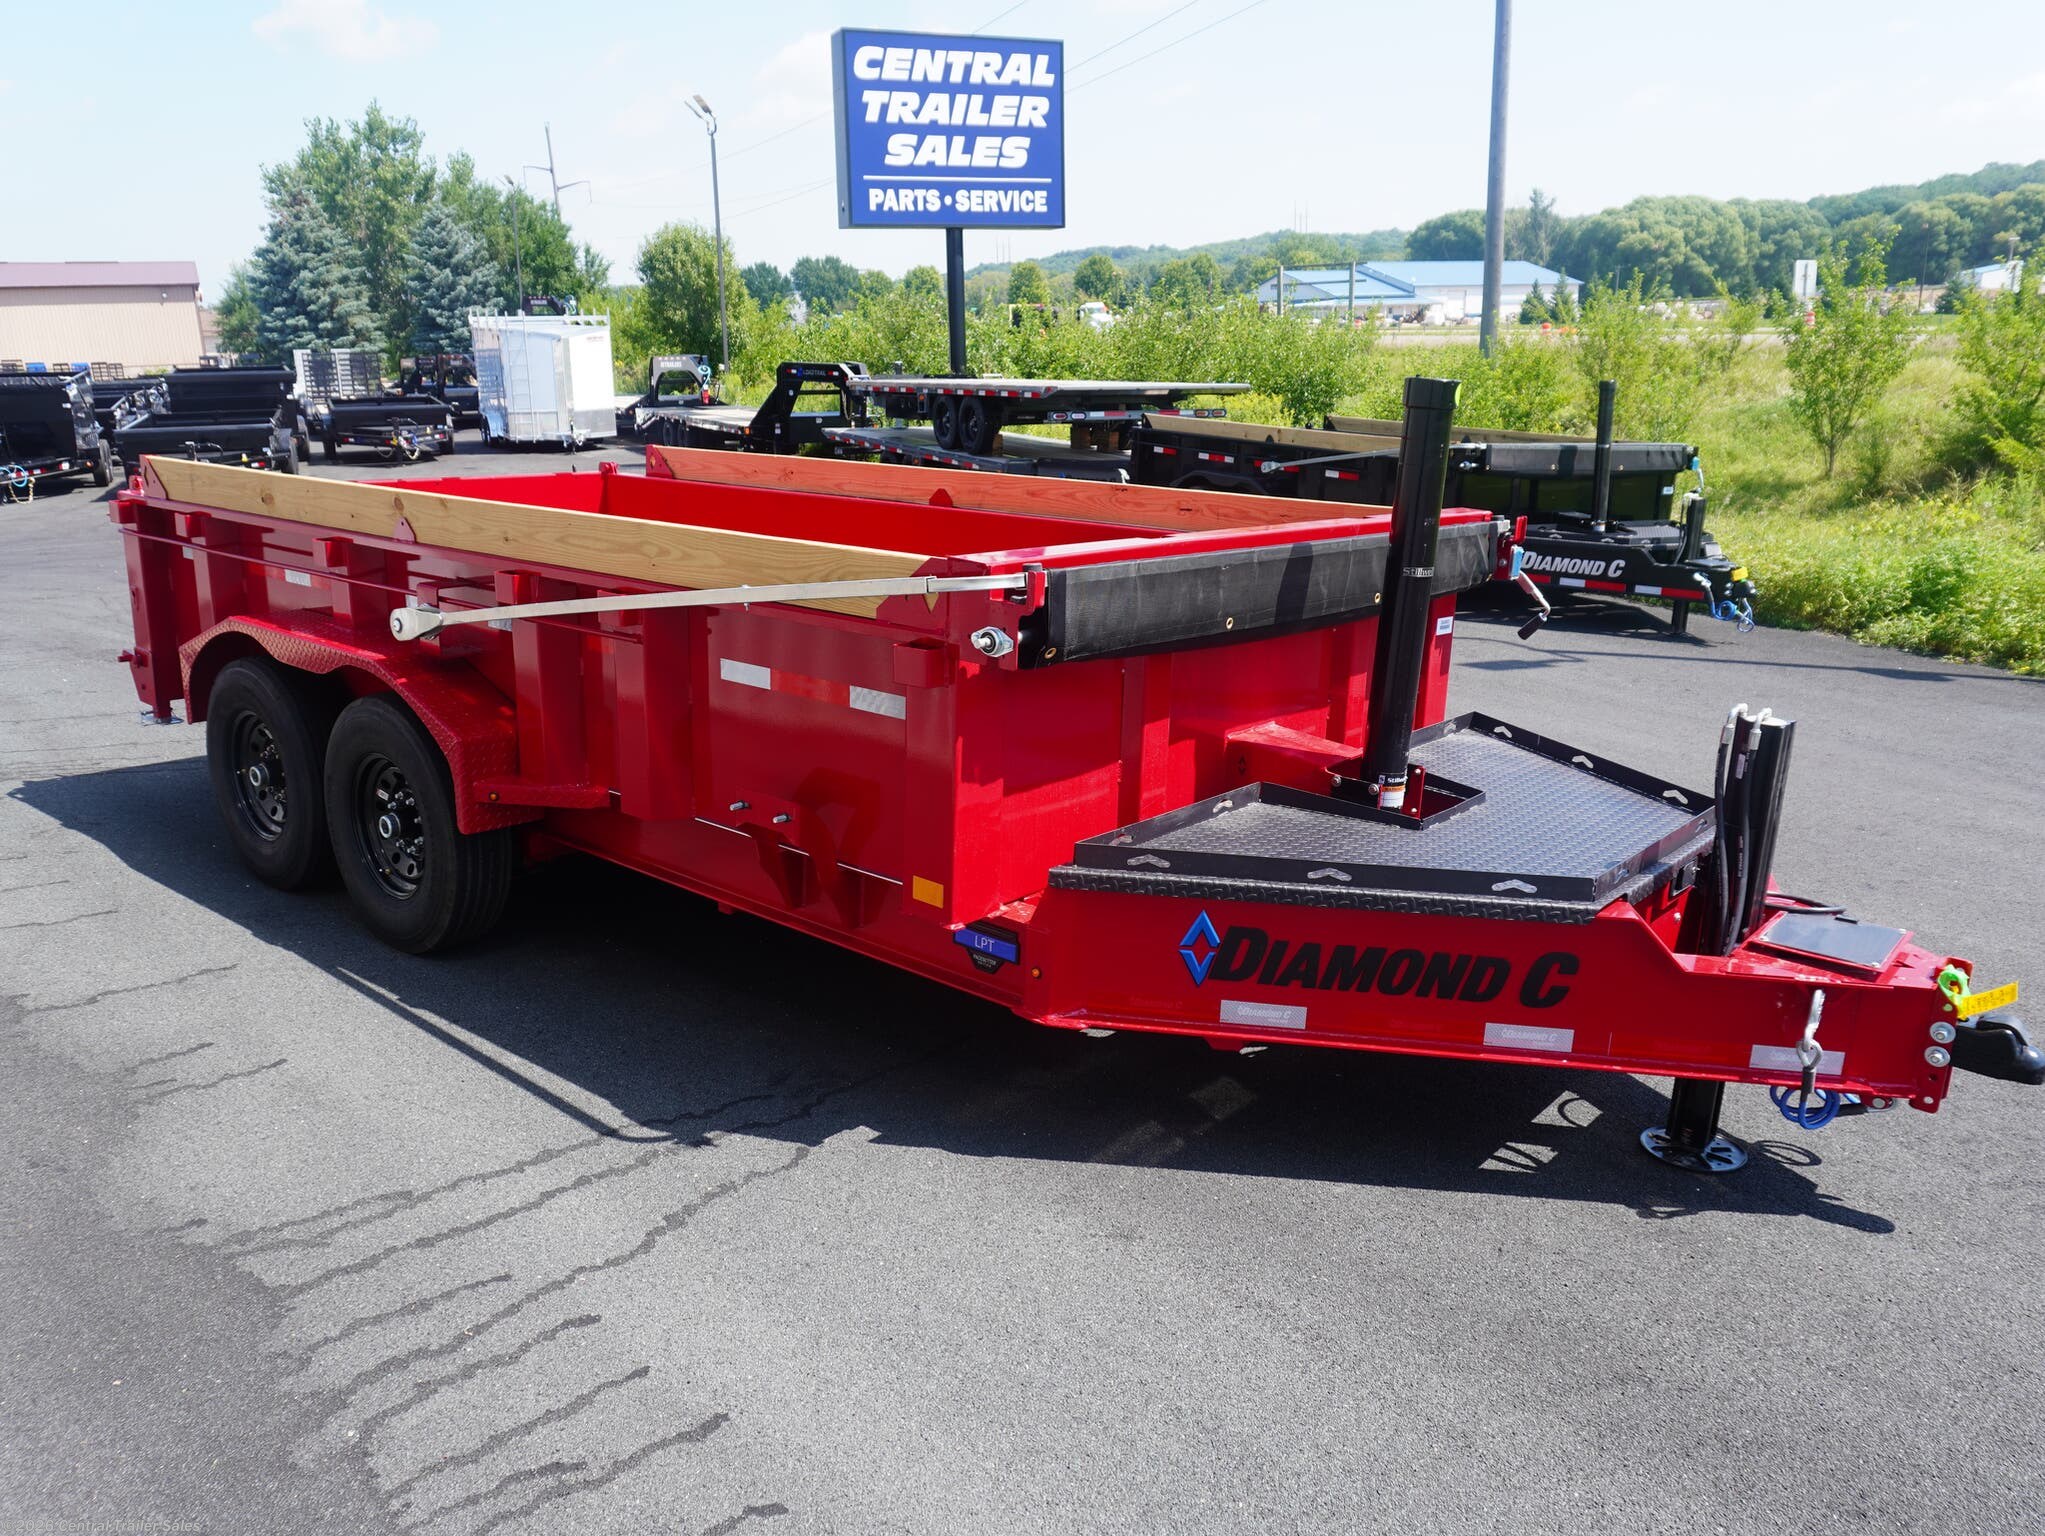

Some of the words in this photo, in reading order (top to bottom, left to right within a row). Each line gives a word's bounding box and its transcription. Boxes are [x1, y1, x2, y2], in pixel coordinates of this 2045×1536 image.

[853, 45, 1055, 87] CENTRAL
[861, 90, 1050, 128] TRAILER
[884, 133, 1031, 168] SALES
[868, 188, 942, 212] PARTS
[955, 189, 1048, 213] SERVICE
[1520, 550, 1607, 577] DIAMOND
[1607, 559, 1626, 578] C
[974, 935, 995, 952] LPT
[1208, 924, 1511, 1003] DIAMOND
[1519, 951, 1581, 1009] C
